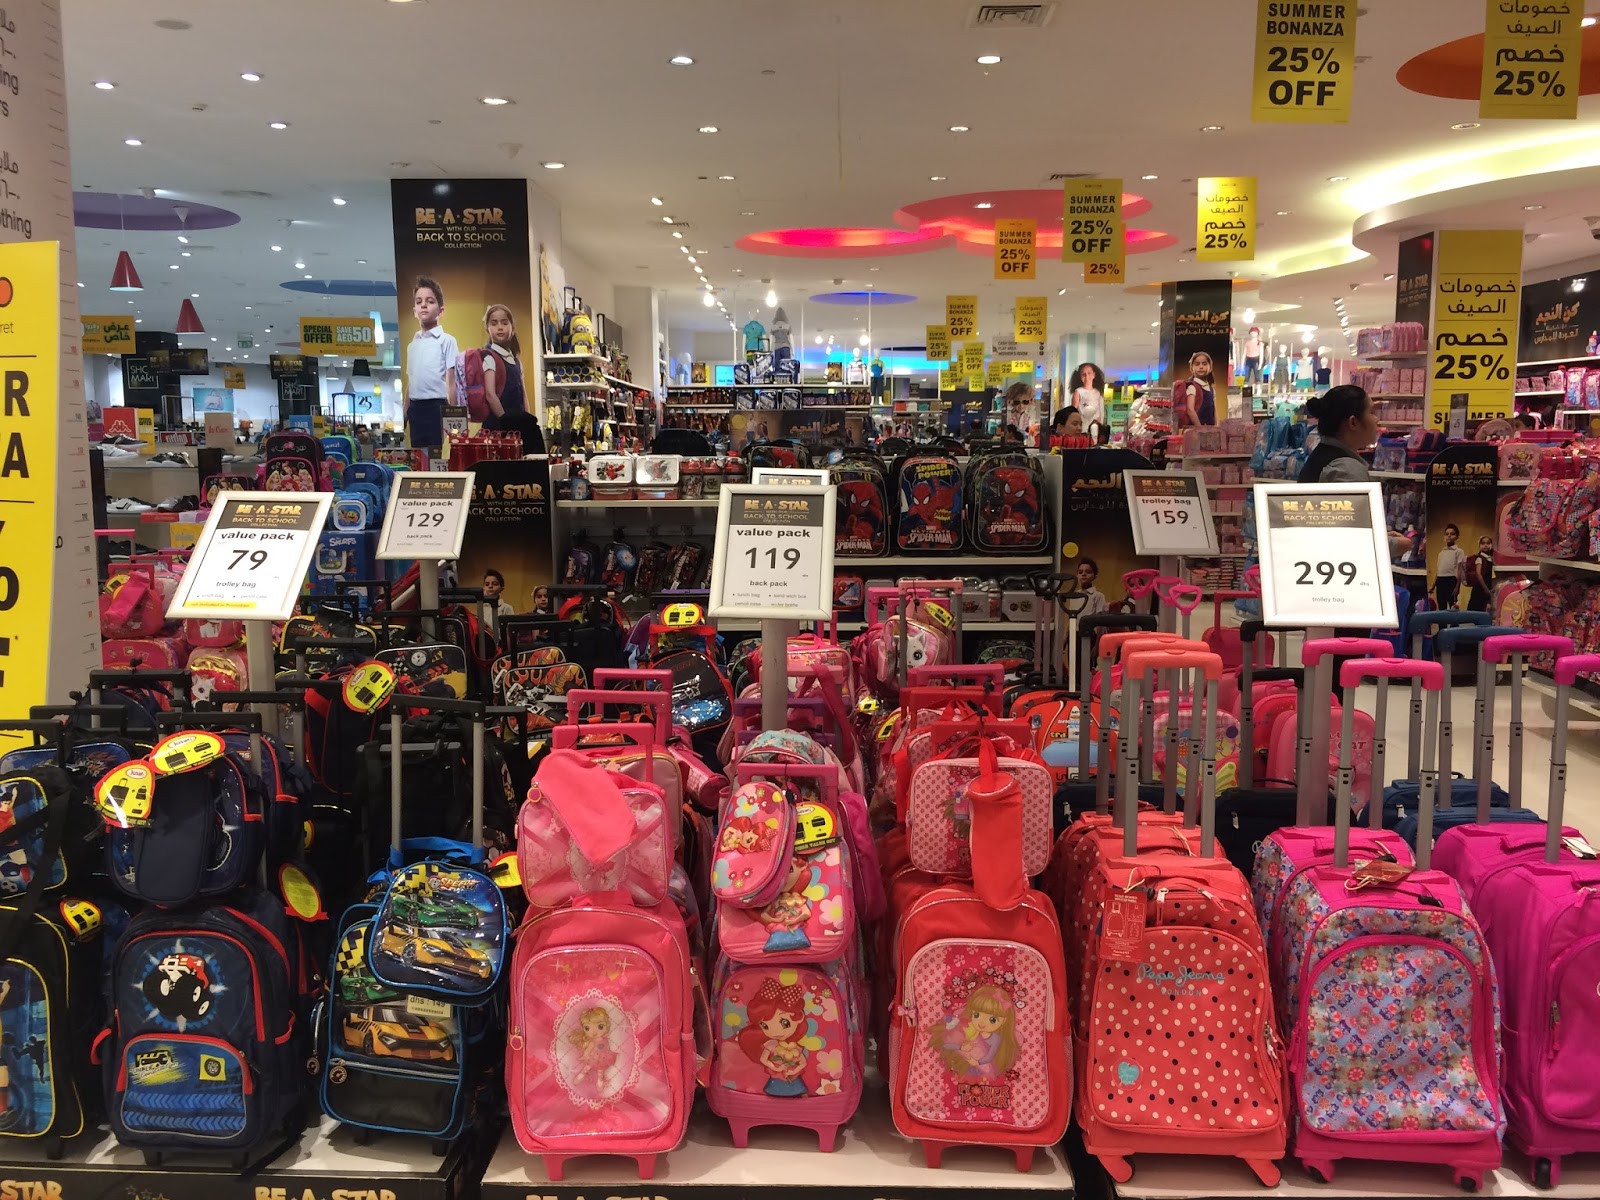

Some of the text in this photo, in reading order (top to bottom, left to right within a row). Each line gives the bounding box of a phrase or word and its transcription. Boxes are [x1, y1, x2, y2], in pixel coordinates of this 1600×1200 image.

[1268, 3, 1345, 18] SUMMER
[1500, 0, 1570, 18] خصومات
[1267, 21, 1344, 36] BONANZA
[1507, 20, 1561, 36] الصيف
[1267, 47, 1340, 74] 25%
[1496, 44, 1564, 66] خصم
[1494, 70, 1565, 97] 25%
[1269, 80, 1336, 106] OFF
[1070, 196, 1115, 204] SUMMER
[1206, 194, 1249, 205] خصومات
[416, 208, 506, 225] BE A STAR
[1070, 206, 1115, 214] BONANZA
[1211, 204, 1244, 215] الصيف
[1071, 220, 1113, 235] 25%
[1205, 218, 1245, 232] خصم
[417, 233, 506, 241] BACK TO SCHOOL
[1205, 233, 1247, 249] 25%
[1071, 239, 1111, 253] OFF
[1000, 249, 1030, 260] 25%
[1001, 262, 1029, 272] OFF
[1089, 263, 1120, 274] 25%
[1440, 278, 1516, 297] خصومات
[1447, 299, 1506, 317] الصيف
[950, 317, 973, 326] 25%
[1177, 310, 1229, 324] كن النجم
[303, 325, 332, 333] SPECIAL
[352, 327, 372, 342] 50
[951, 327, 972, 336] OFF
[1019, 327, 1043, 336] 25%
[304, 334, 332, 343] OFFER
[337, 334, 352, 342] AED
[1436, 328, 1508, 350] خصم
[1435, 354, 1509, 380] 25%
[916, 463, 948, 473] SPIDER
[1432, 463, 1494, 475] BE A STAR
[484, 484, 496, 499] A
[503, 483, 545, 500] STAR
[236, 505, 302, 516] BE A STAR
[467, 506, 545, 515] ACK TO SCHOOL
[744, 500, 810, 511] BE A STAR
[1282, 500, 1355, 511] BE A STAR
[406, 513, 445, 527] 129
[1151, 510, 1189, 525] 159
[221, 531, 295, 541] value pack
[737, 528, 811, 538] value pack
[227, 549, 268, 571] 79
[745, 548, 801, 570] 119
[1294, 561, 1358, 586] 299
[1312, 596, 1345, 604] trolley bag
[1137, 963, 1226, 987] Pepe Jeans
[410, 996, 425, 1005] dhs
[960, 1093, 1010, 1108] POWER
[0, 1180, 63, 1200] STAR
